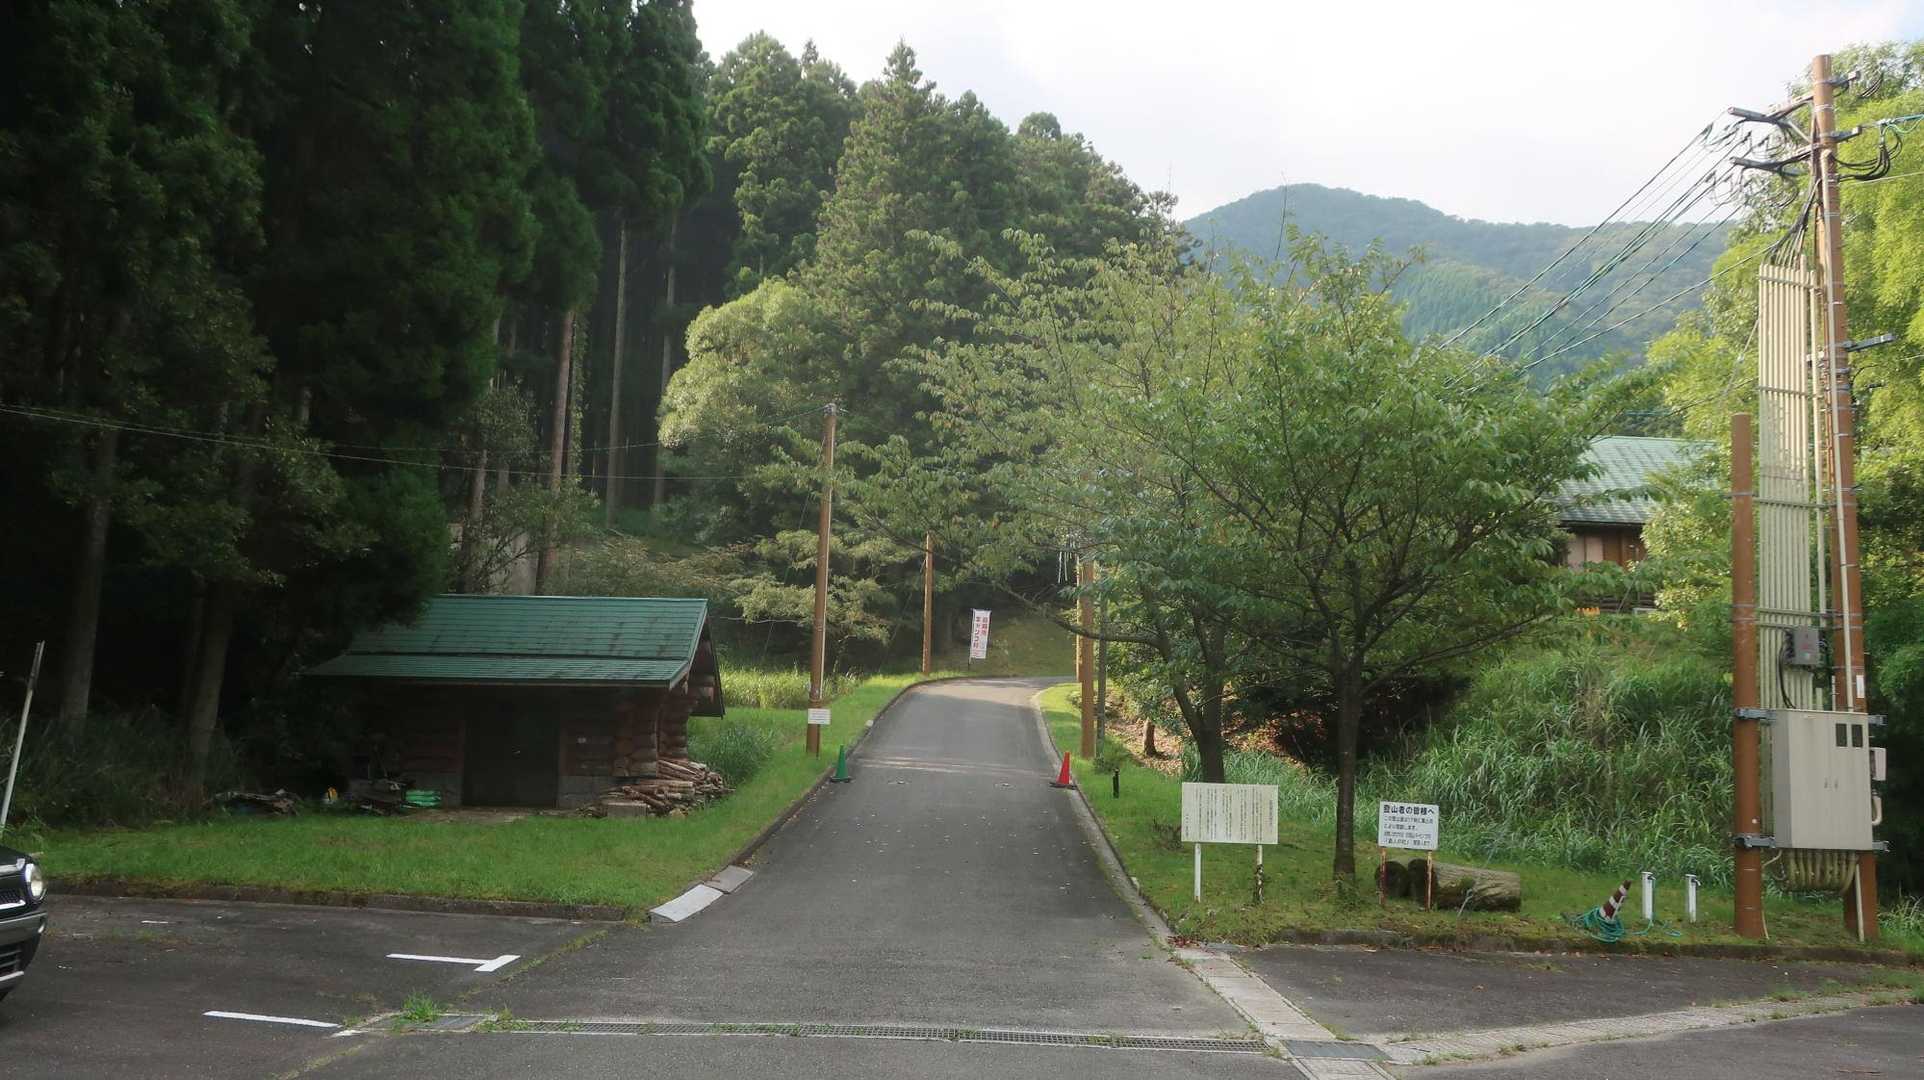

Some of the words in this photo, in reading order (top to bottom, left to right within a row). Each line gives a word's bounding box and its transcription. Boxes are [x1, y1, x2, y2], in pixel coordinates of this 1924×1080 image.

[1383, 804, 1434, 815] 登山者の皆様へ
